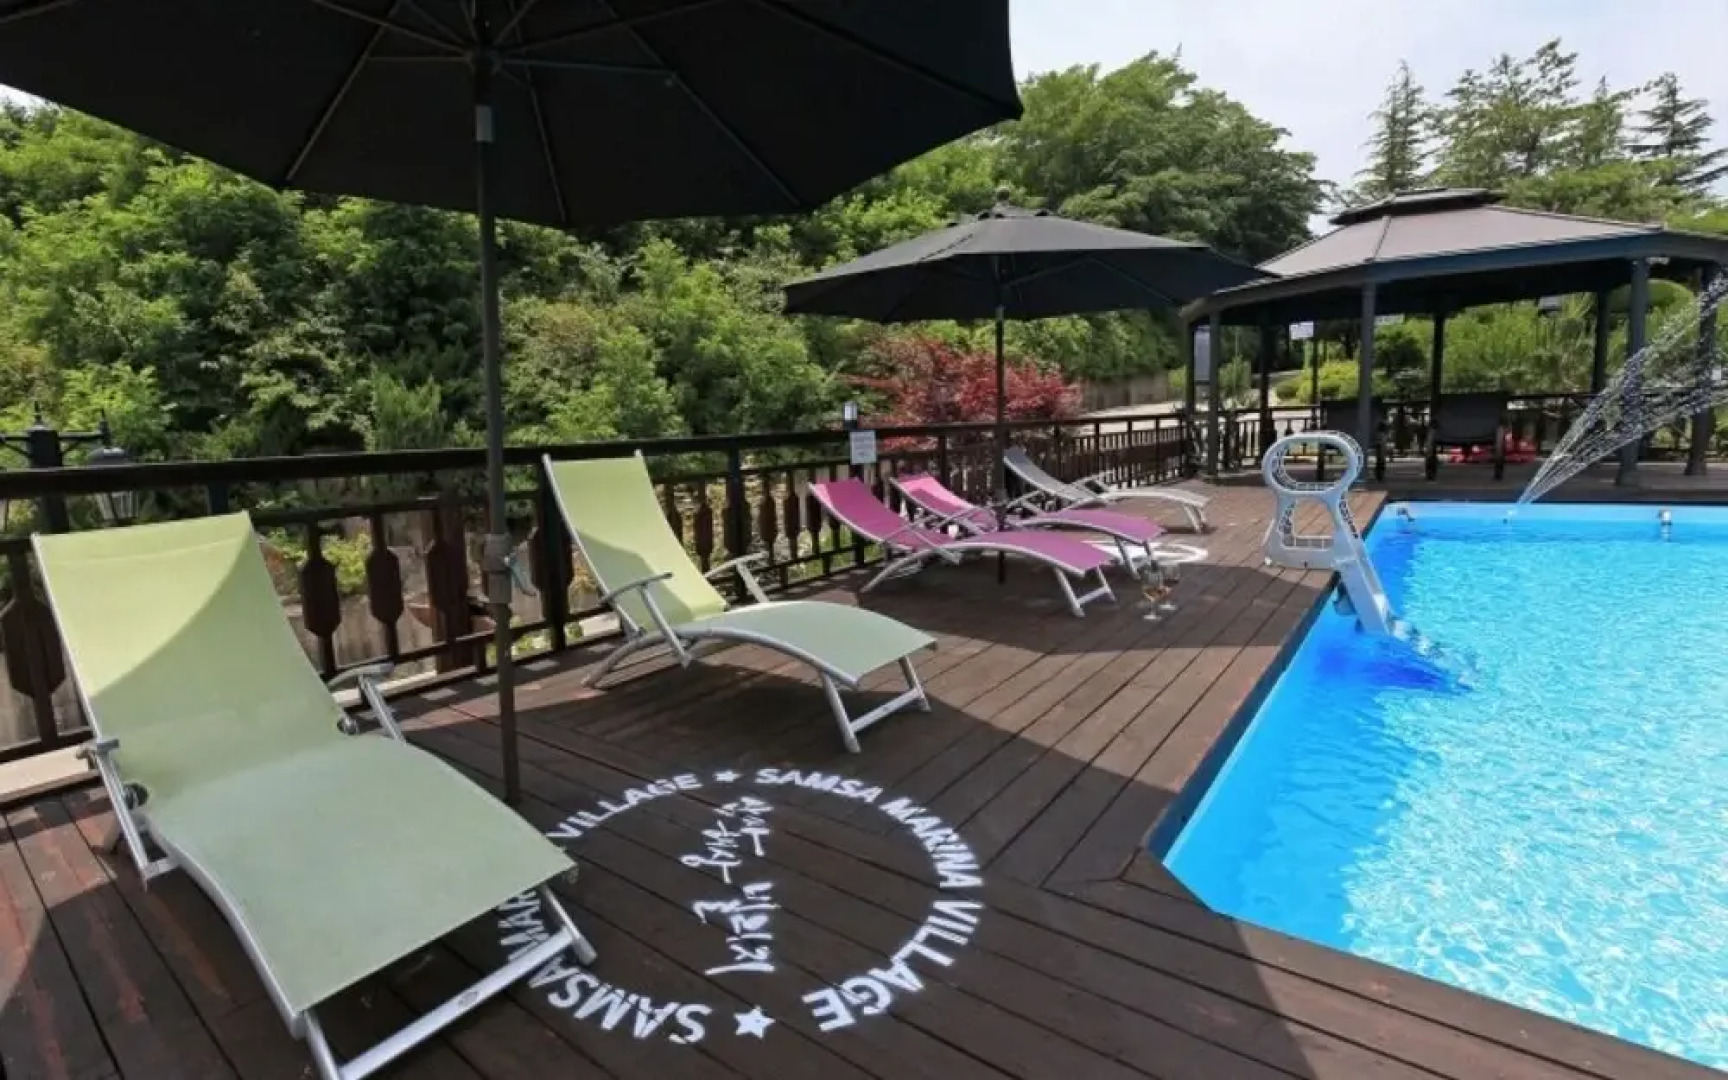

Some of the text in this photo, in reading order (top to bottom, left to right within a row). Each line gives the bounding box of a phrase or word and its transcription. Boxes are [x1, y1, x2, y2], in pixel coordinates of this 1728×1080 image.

[547, 773, 703, 838] VILLAGE
[755, 768, 984, 1031] SAMSA MARINA VILLAGE
[530, 955, 713, 1044] SAMSA
